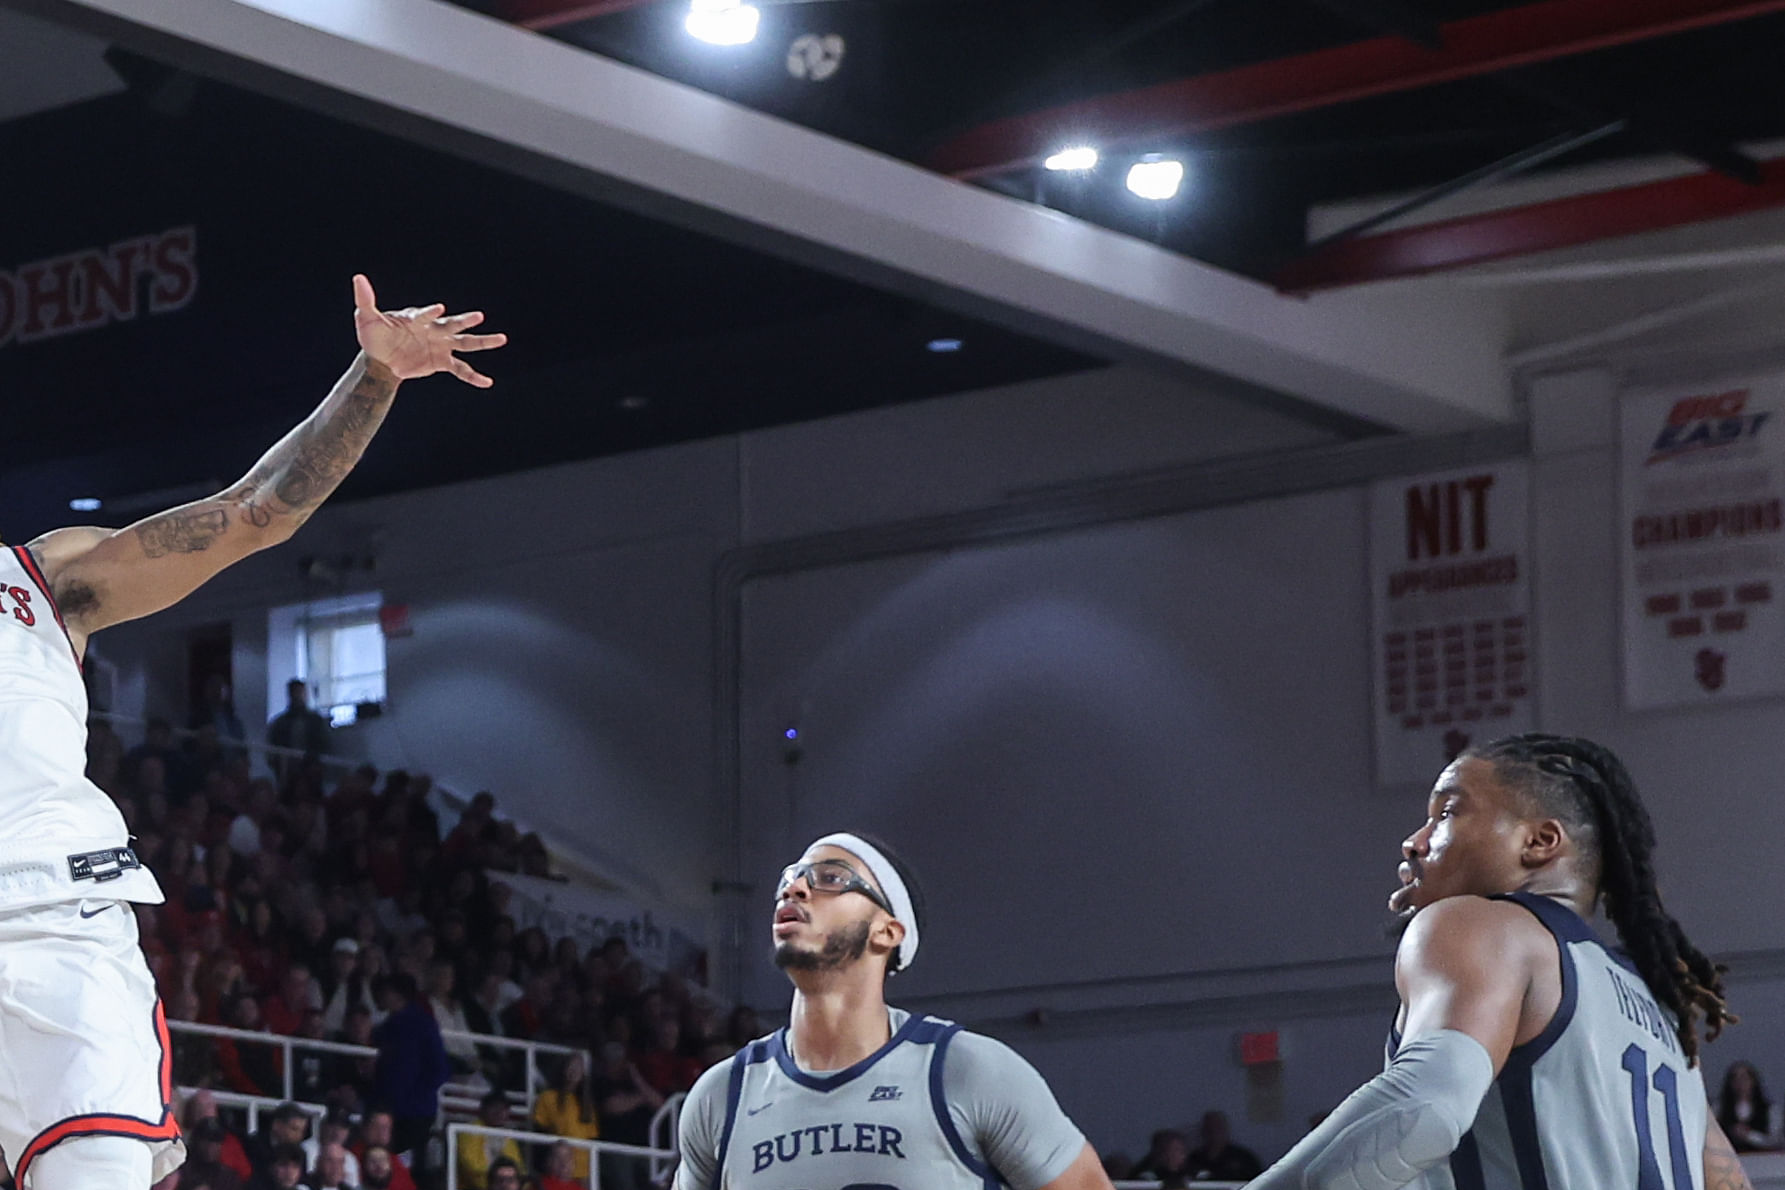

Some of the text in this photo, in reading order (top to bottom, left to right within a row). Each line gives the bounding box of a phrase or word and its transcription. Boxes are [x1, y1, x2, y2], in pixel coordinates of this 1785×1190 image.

[1667, 388, 1751, 426] BIG
[1652, 410, 1771, 451] EAST
[1405, 474, 1495, 561] NIT
[752, 1122, 907, 1174] BUTLER
